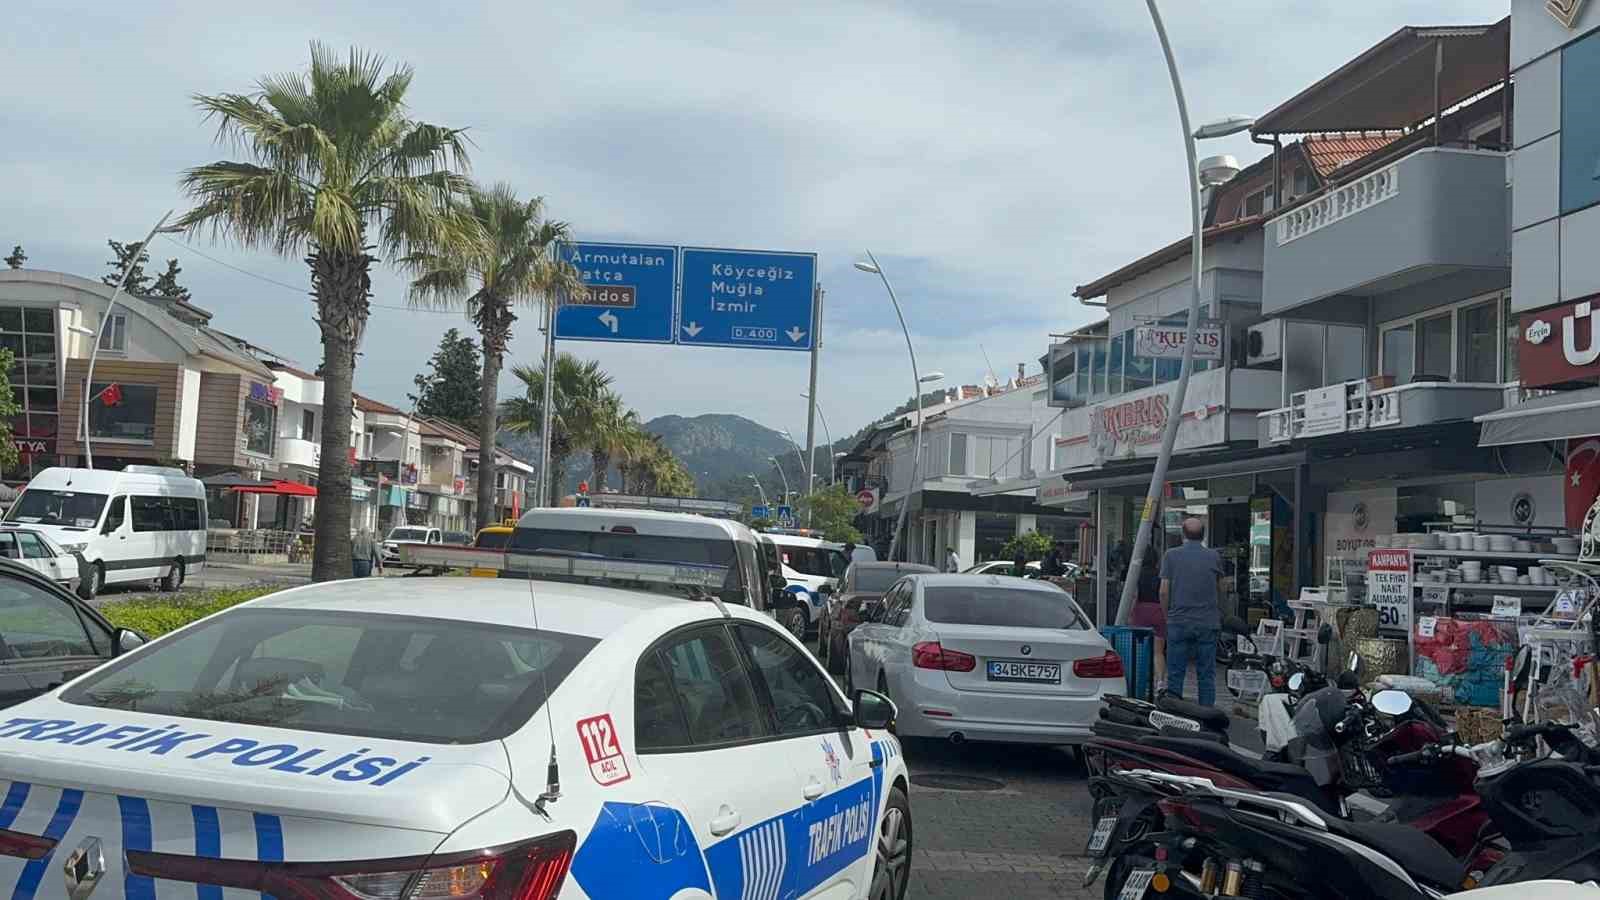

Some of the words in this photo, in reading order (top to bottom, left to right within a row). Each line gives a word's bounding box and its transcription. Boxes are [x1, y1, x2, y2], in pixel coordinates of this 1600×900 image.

[571, 251, 665, 266] Armutalan
[712, 263, 793, 281] Köyceğiz
[711, 281, 763, 297] Muğla
[711, 295, 757, 312] İzmir
[1380, 606, 1399, 625] 50
[581, 719, 619, 760] 112
[0, 718, 211, 754] TRAFİK
[186, 738, 432, 786] POLİSİ
[808, 804, 844, 867] TRAFİK
